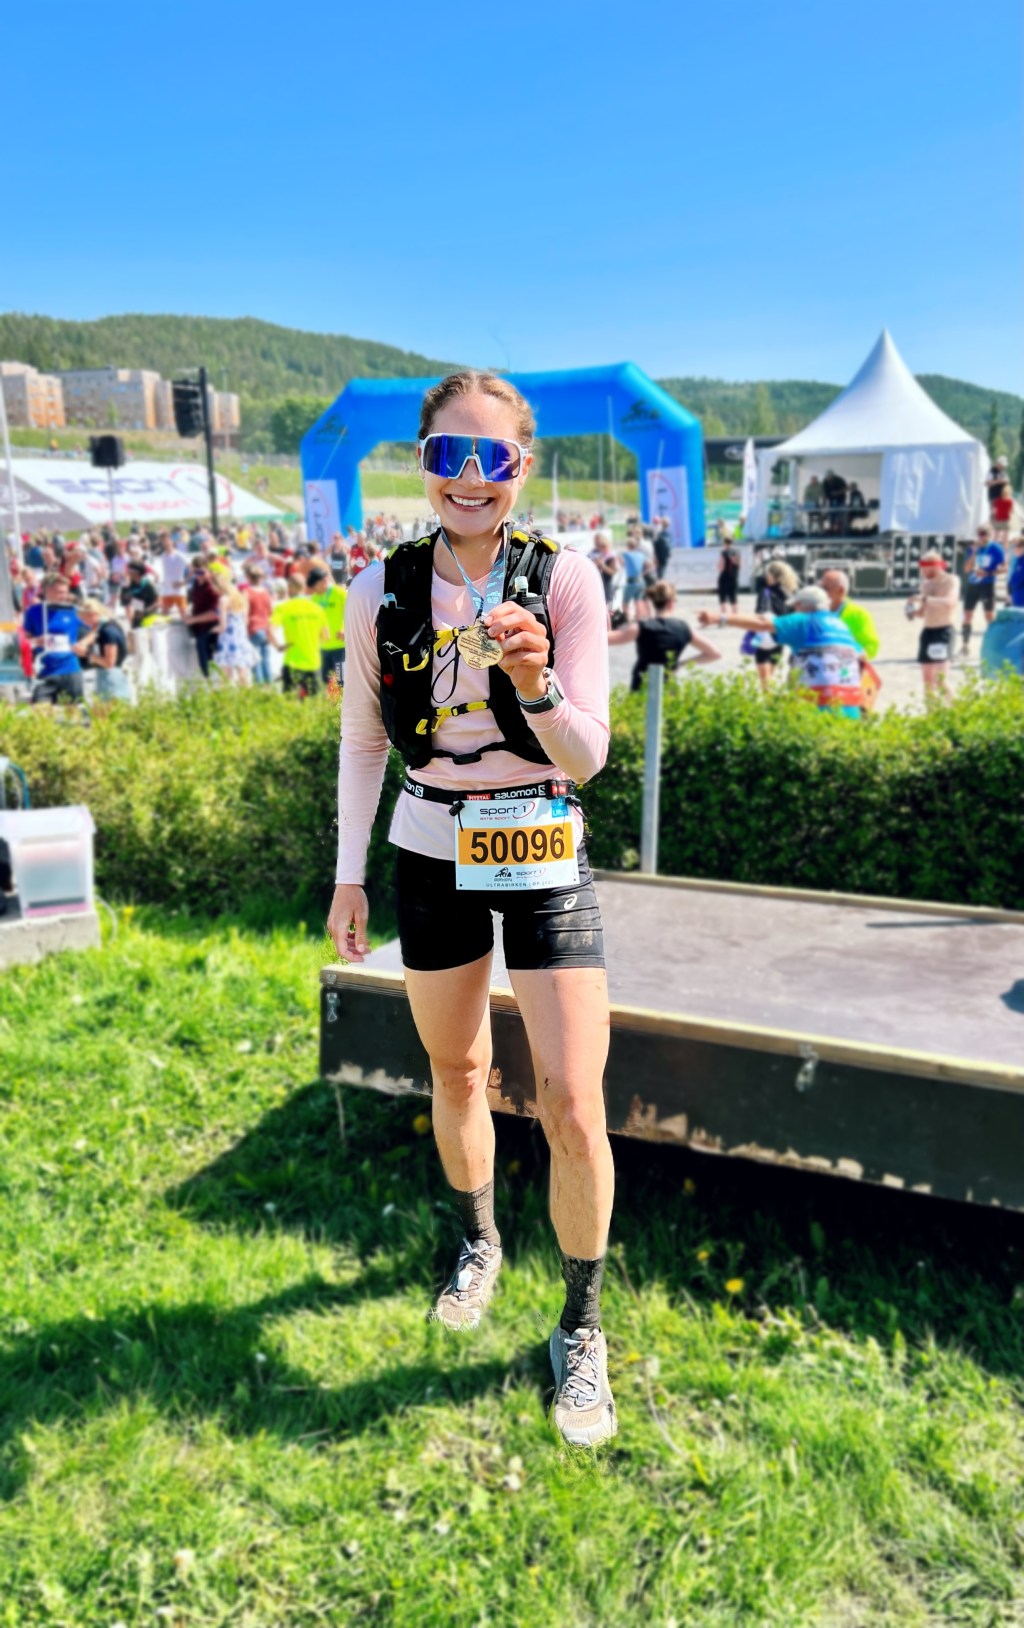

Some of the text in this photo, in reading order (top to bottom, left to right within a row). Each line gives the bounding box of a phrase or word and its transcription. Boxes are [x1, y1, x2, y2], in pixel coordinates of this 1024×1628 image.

[480, 805, 527, 816] sport 1
[471, 827, 565, 864] 50096
